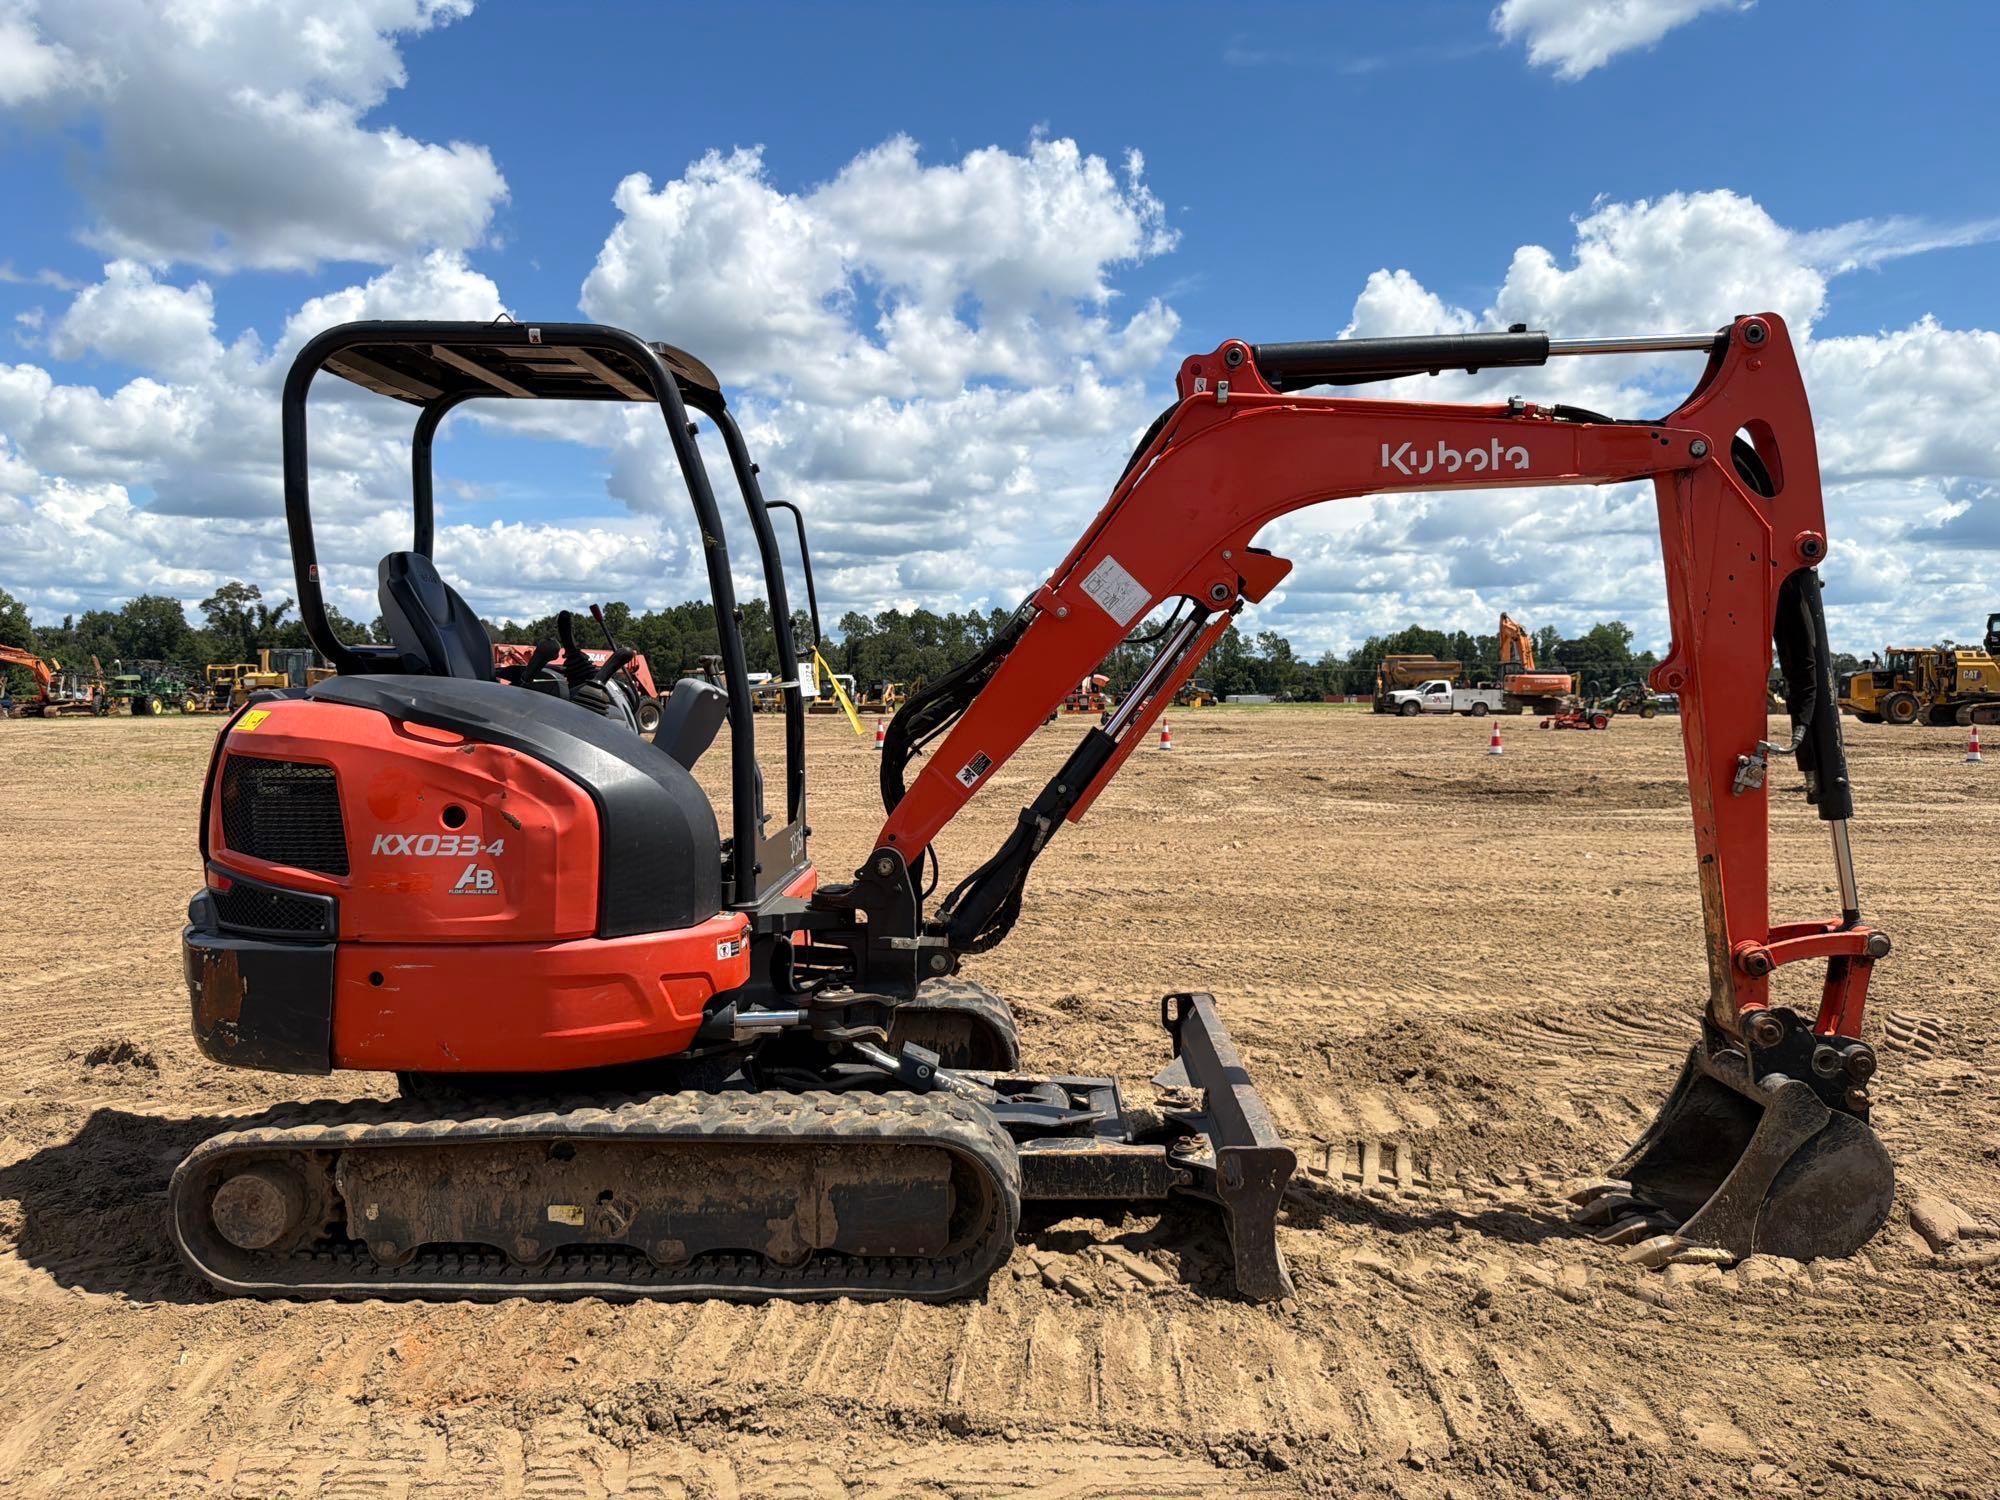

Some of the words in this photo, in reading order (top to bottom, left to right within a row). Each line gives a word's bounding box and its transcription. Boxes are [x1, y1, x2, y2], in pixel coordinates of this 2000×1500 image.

[1381, 437, 1530, 475] Kubota
[1963, 670, 1979, 680] CAT
[371, 834, 504, 857] KX033-4
